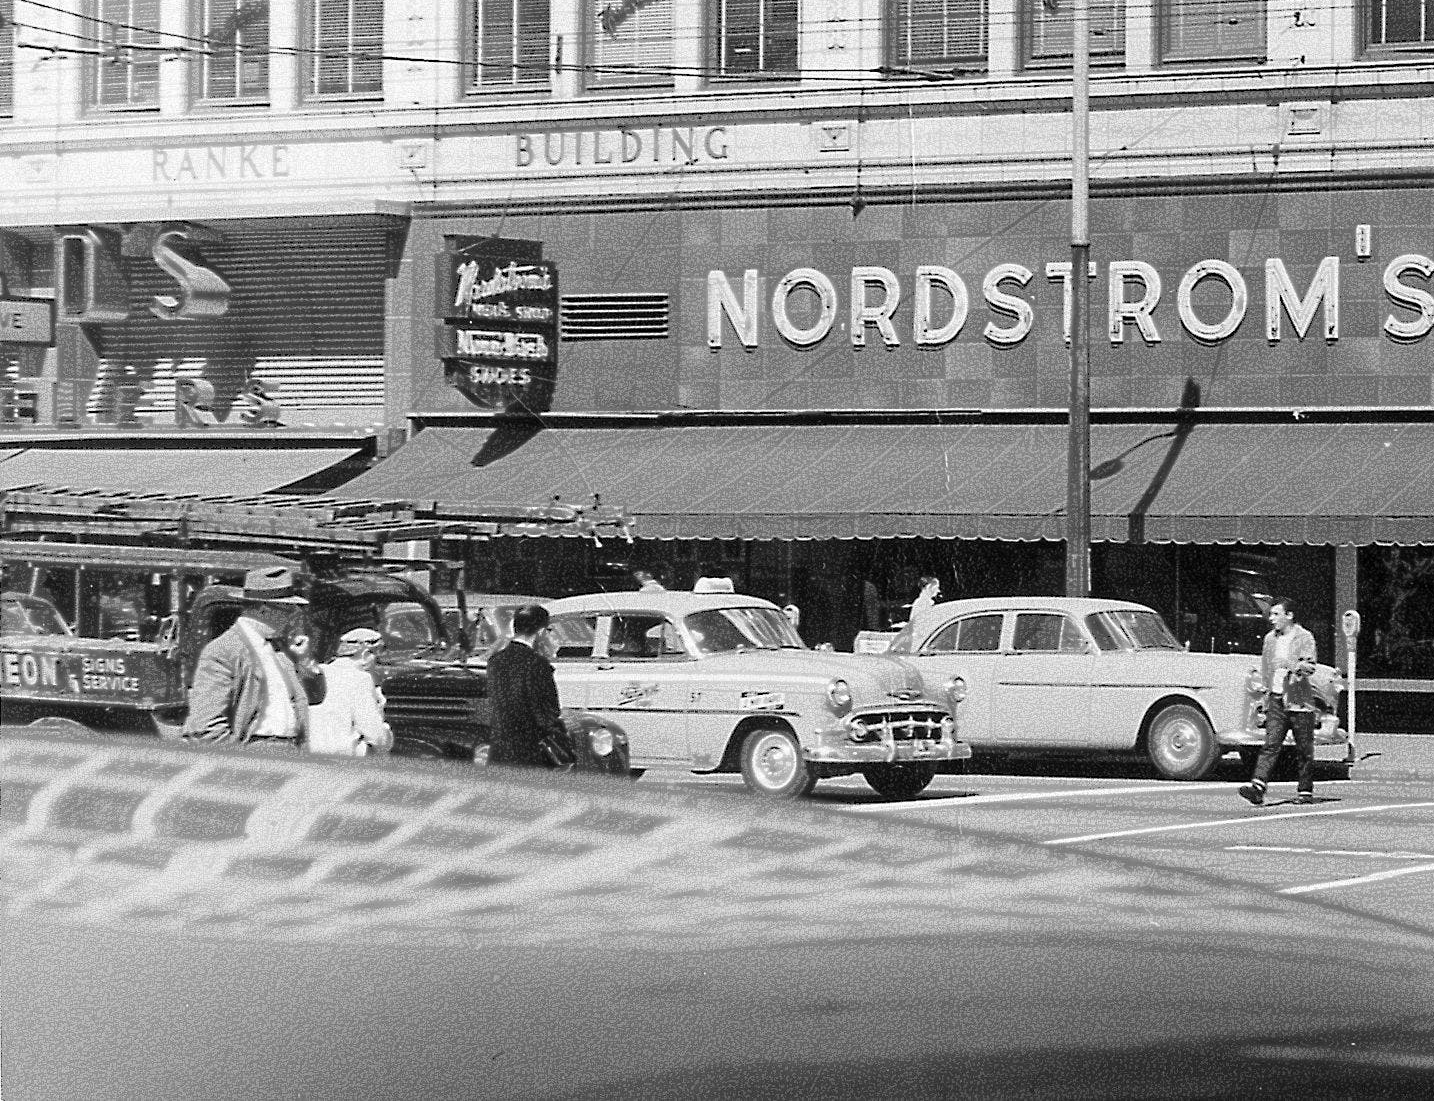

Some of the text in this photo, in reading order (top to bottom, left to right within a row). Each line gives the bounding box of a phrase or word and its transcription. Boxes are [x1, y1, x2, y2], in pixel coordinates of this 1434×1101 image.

[152, 127, 728, 182] RANKE BUILDING
[82, 674, 140, 692] SERVICE
